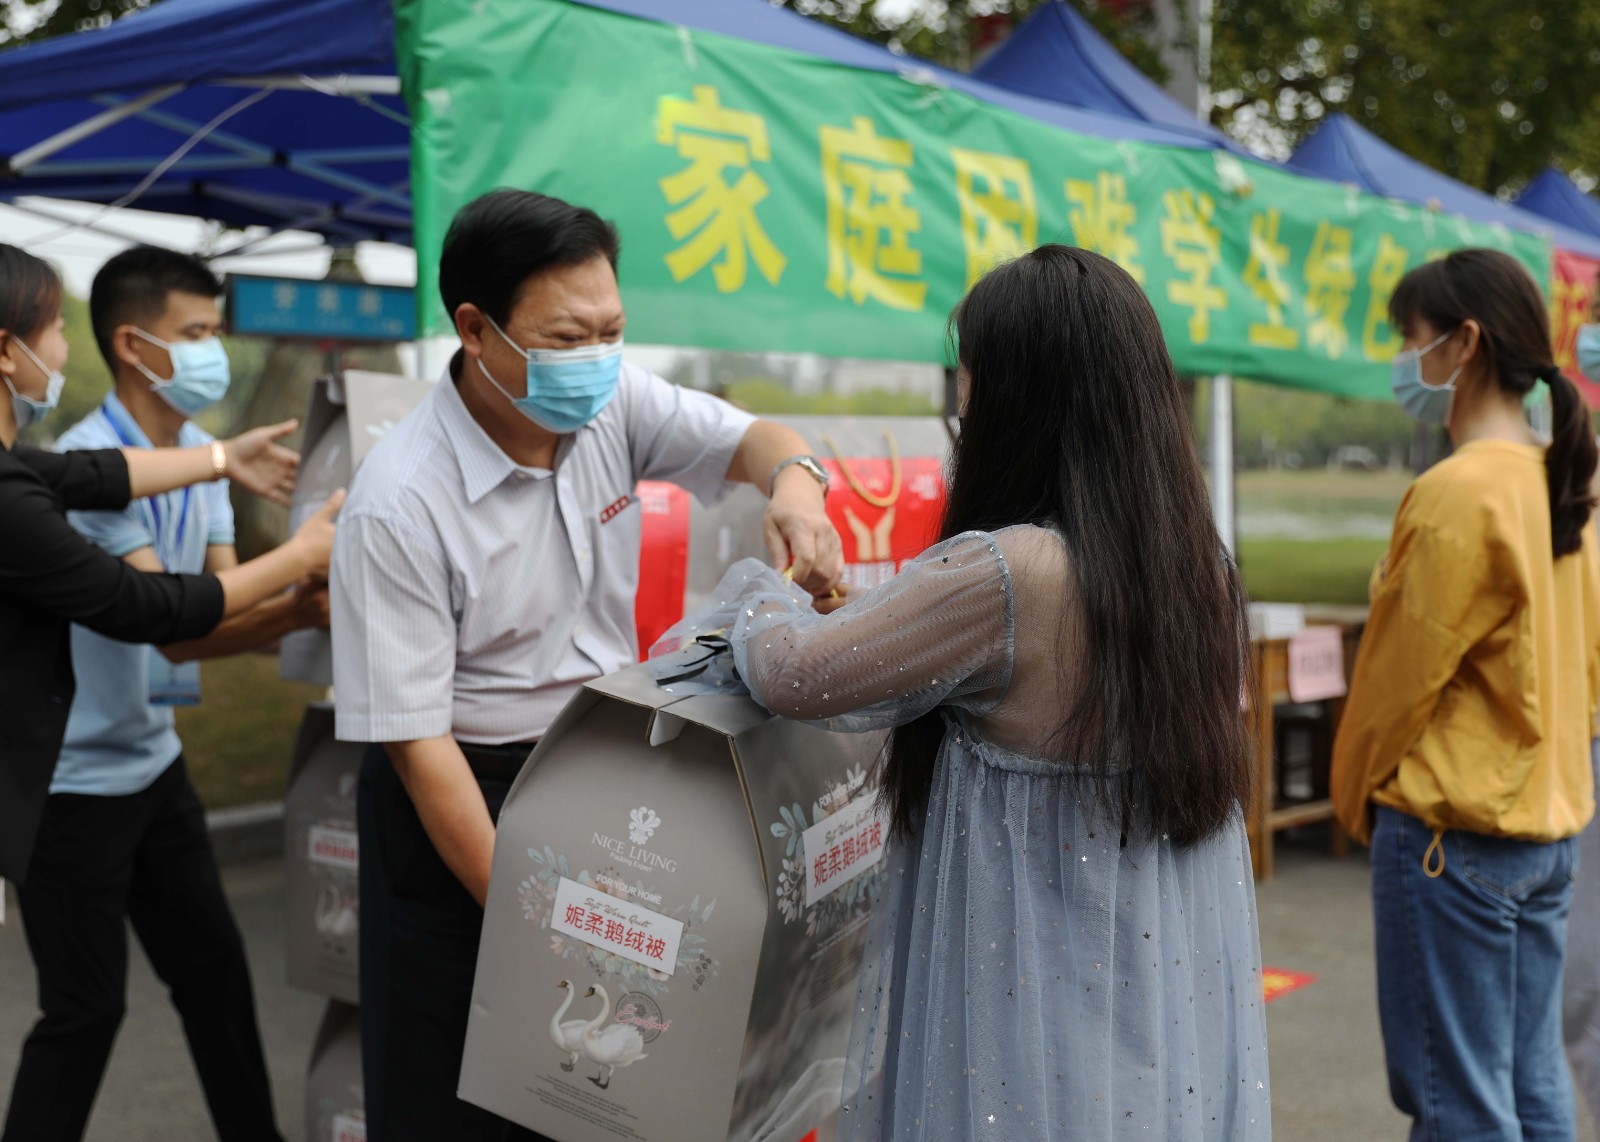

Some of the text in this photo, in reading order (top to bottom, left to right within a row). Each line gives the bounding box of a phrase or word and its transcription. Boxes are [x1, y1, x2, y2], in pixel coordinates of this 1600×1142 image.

[655, 84, 1447, 364] 家庭困难学生绿色
[592, 832, 677, 873] NICE LIVING
[814, 820, 882, 888] 妮柔鹅绒被
[596, 874, 663, 905] FOR YOUR HOME
[564, 903, 667, 961] 妮柔鹅绒被
